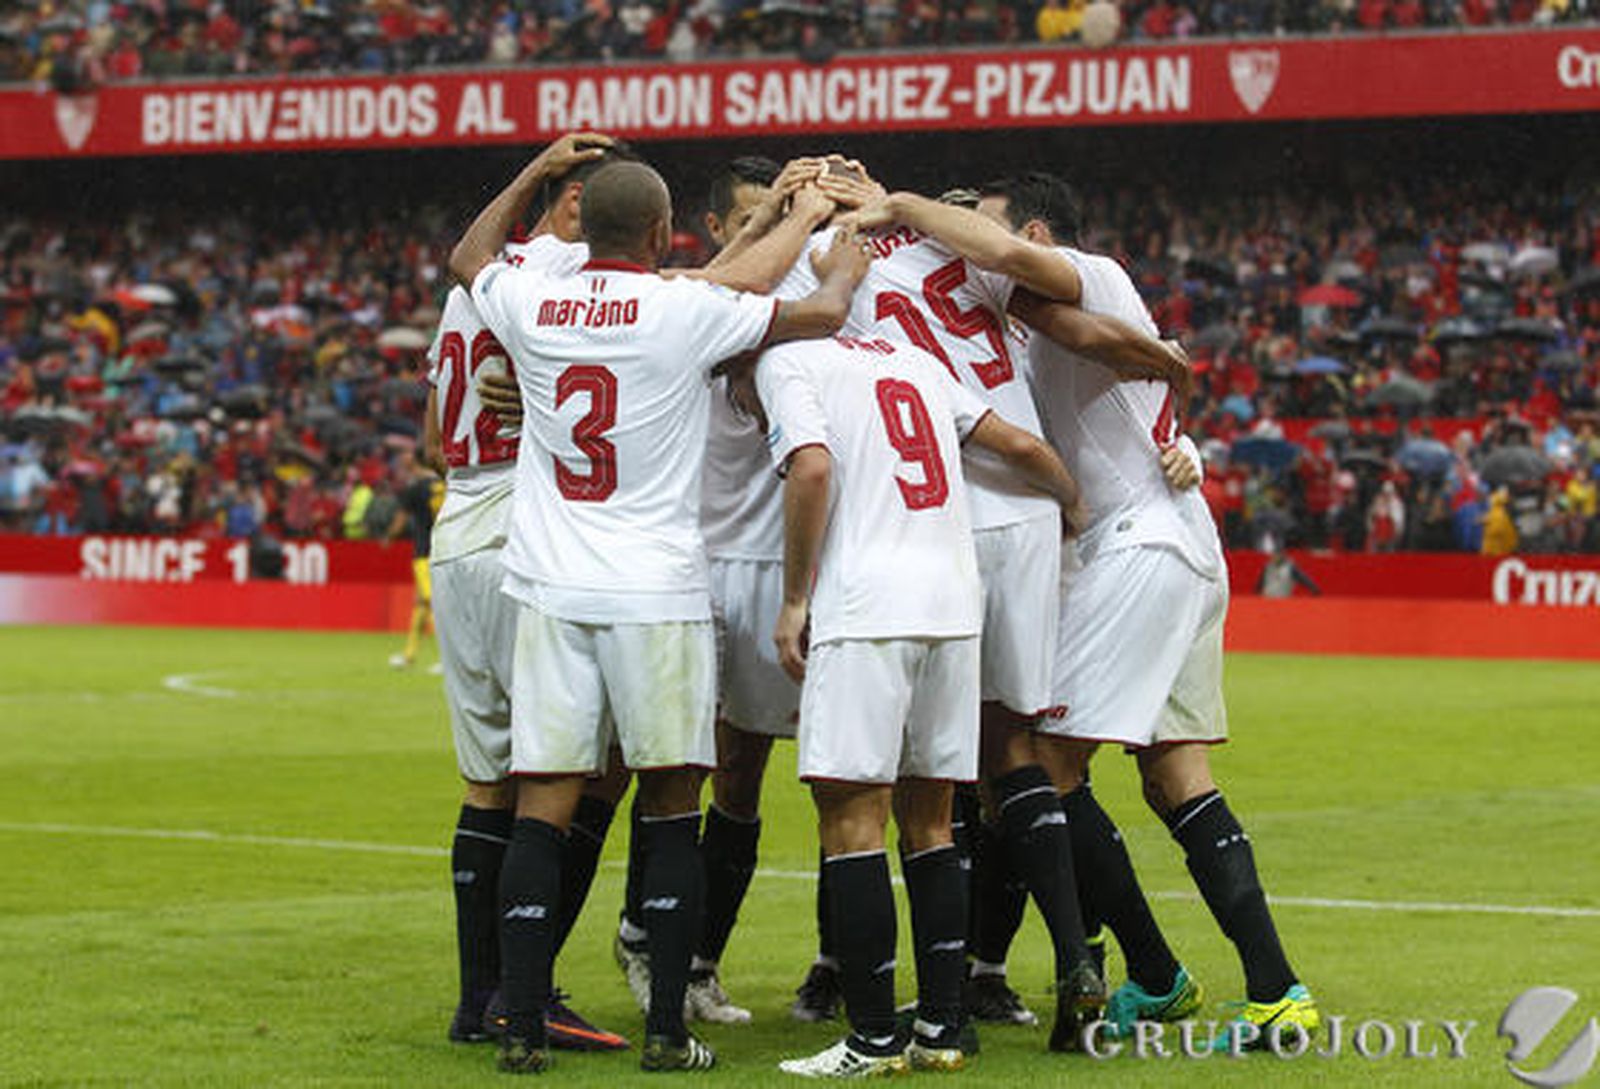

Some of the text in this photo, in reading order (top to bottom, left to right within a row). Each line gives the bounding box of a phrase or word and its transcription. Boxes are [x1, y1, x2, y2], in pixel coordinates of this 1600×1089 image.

[141, 55, 1191, 145] BIENVENIDOS AL RAMON SANCHEZ-PIZJUAN
[536, 297, 640, 328] mariano
[874, 255, 1015, 390] 15
[435, 330, 519, 468] 22
[552, 364, 619, 503] 3
[875, 377, 950, 511] 9
